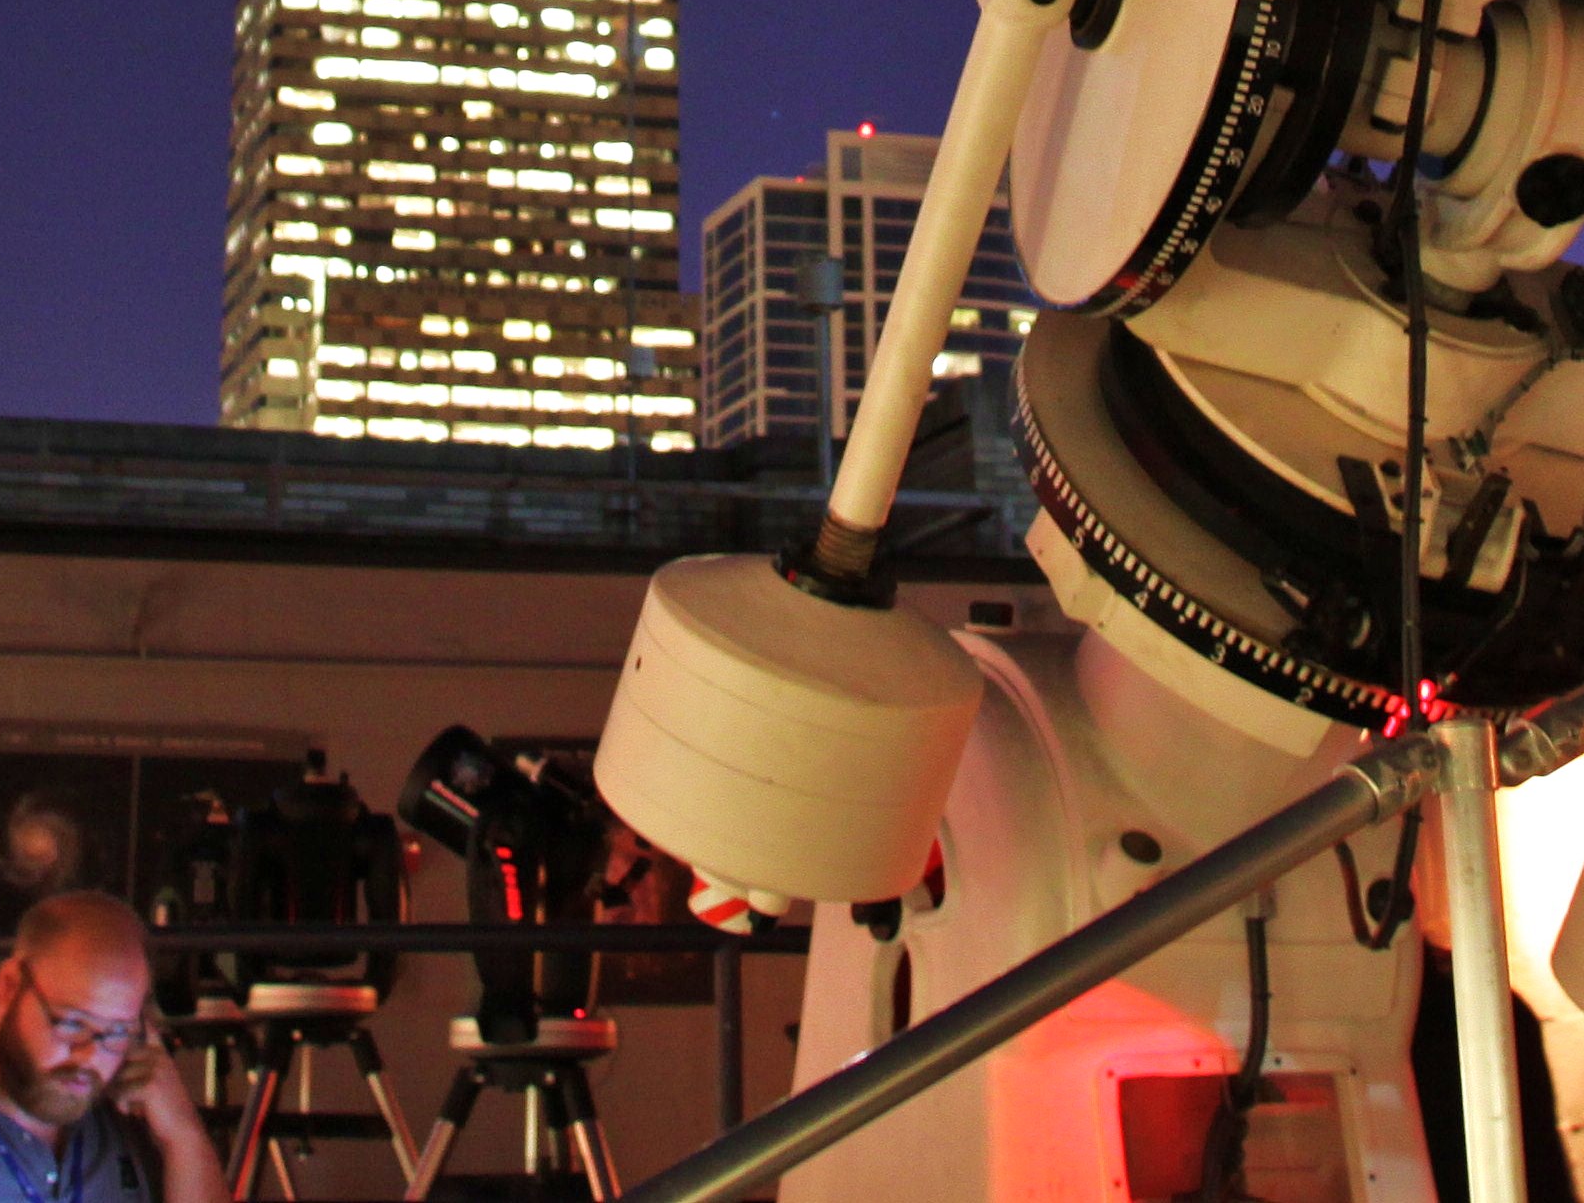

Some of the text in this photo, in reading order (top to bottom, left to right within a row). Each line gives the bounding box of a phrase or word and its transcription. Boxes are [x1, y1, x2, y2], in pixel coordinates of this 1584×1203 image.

[1073, 526, 1086, 547] 5
[1134, 592, 1148, 610] 4
[1211, 643, 1227, 664] 3
[1294, 688, 1313, 706] 2
